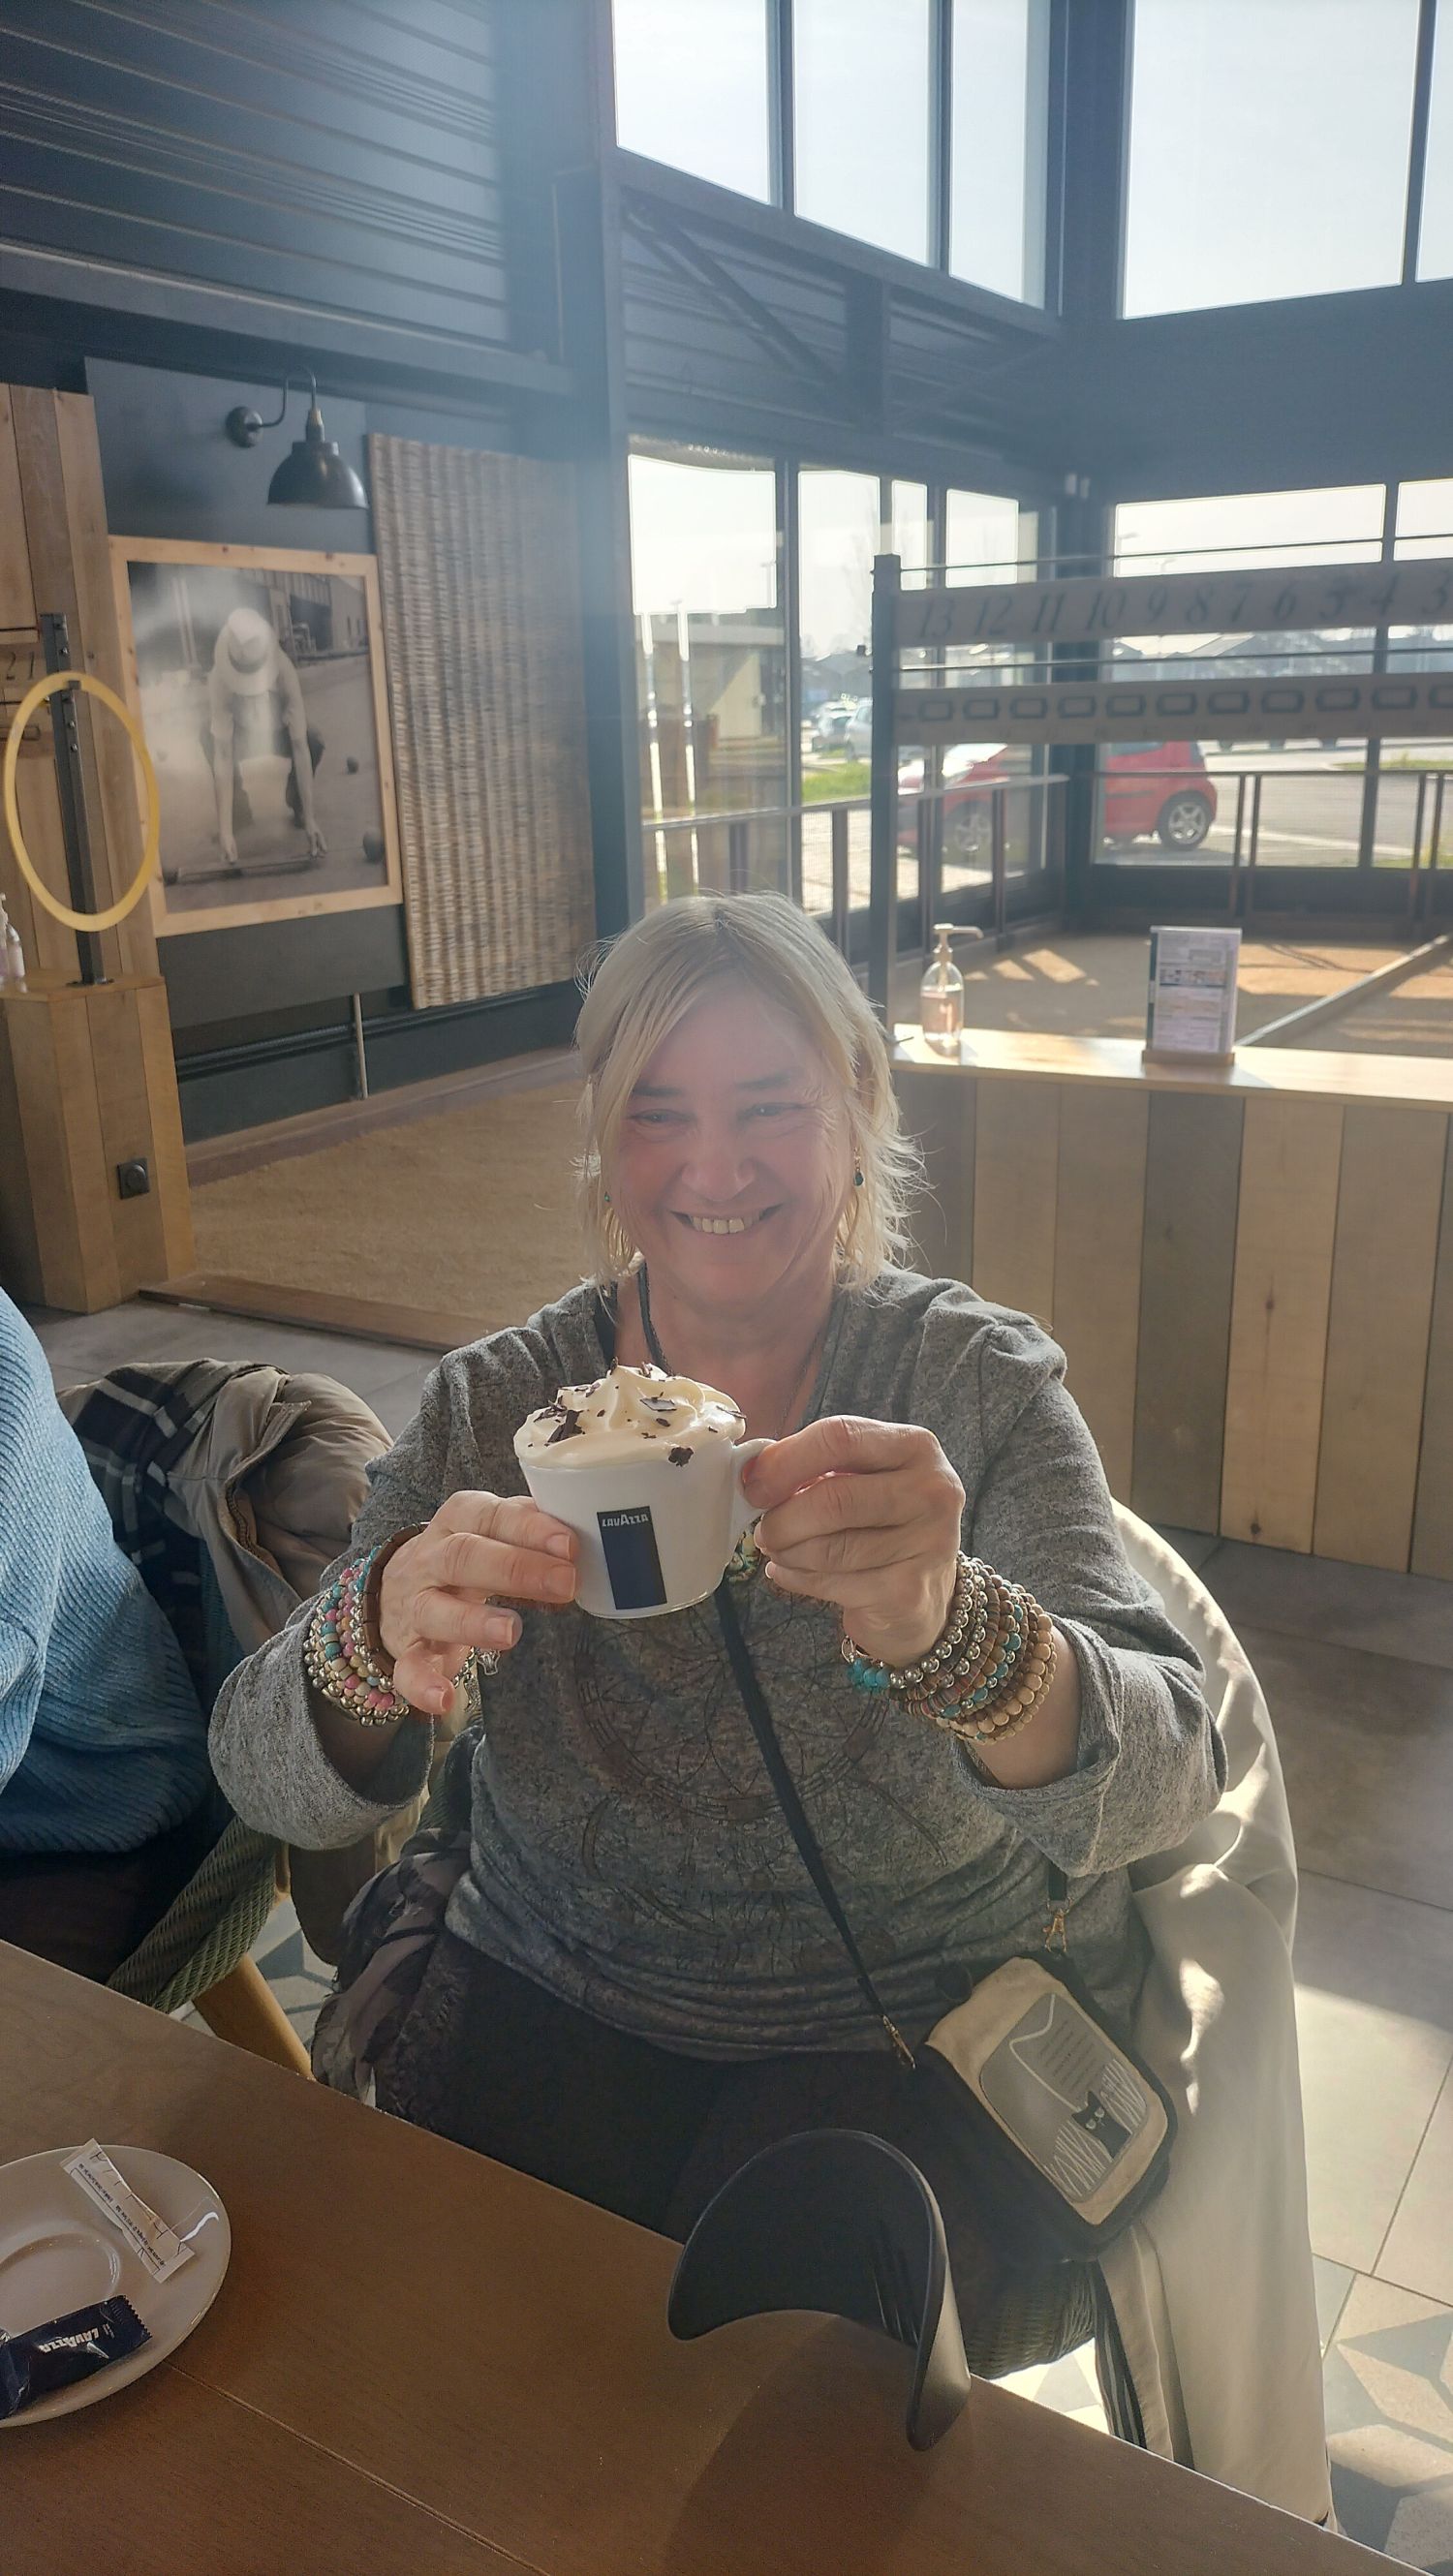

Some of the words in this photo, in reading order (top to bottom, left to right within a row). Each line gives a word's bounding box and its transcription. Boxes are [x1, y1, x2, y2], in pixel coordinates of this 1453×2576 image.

[917, 598, 955, 638] 13
[974, 595, 1012, 634] 12
[1030, 592, 1066, 632] 11
[1084, 588, 1127, 630] 10
[1146, 587, 1169, 624] 9
[1185, 584, 1214, 625] 8
[1229, 582, 1256, 622] 7
[1270, 581, 1296, 621] 6
[1319, 580, 1355, 621] 5
[1371, 573, 1400, 616] 4
[1421, 567, 1453, 616] 3
[6, 651, 16, 680] 2
[602, 1513, 649, 1527] LAVAZZA
[39, 2327, 99, 2354] LAVAZZA
